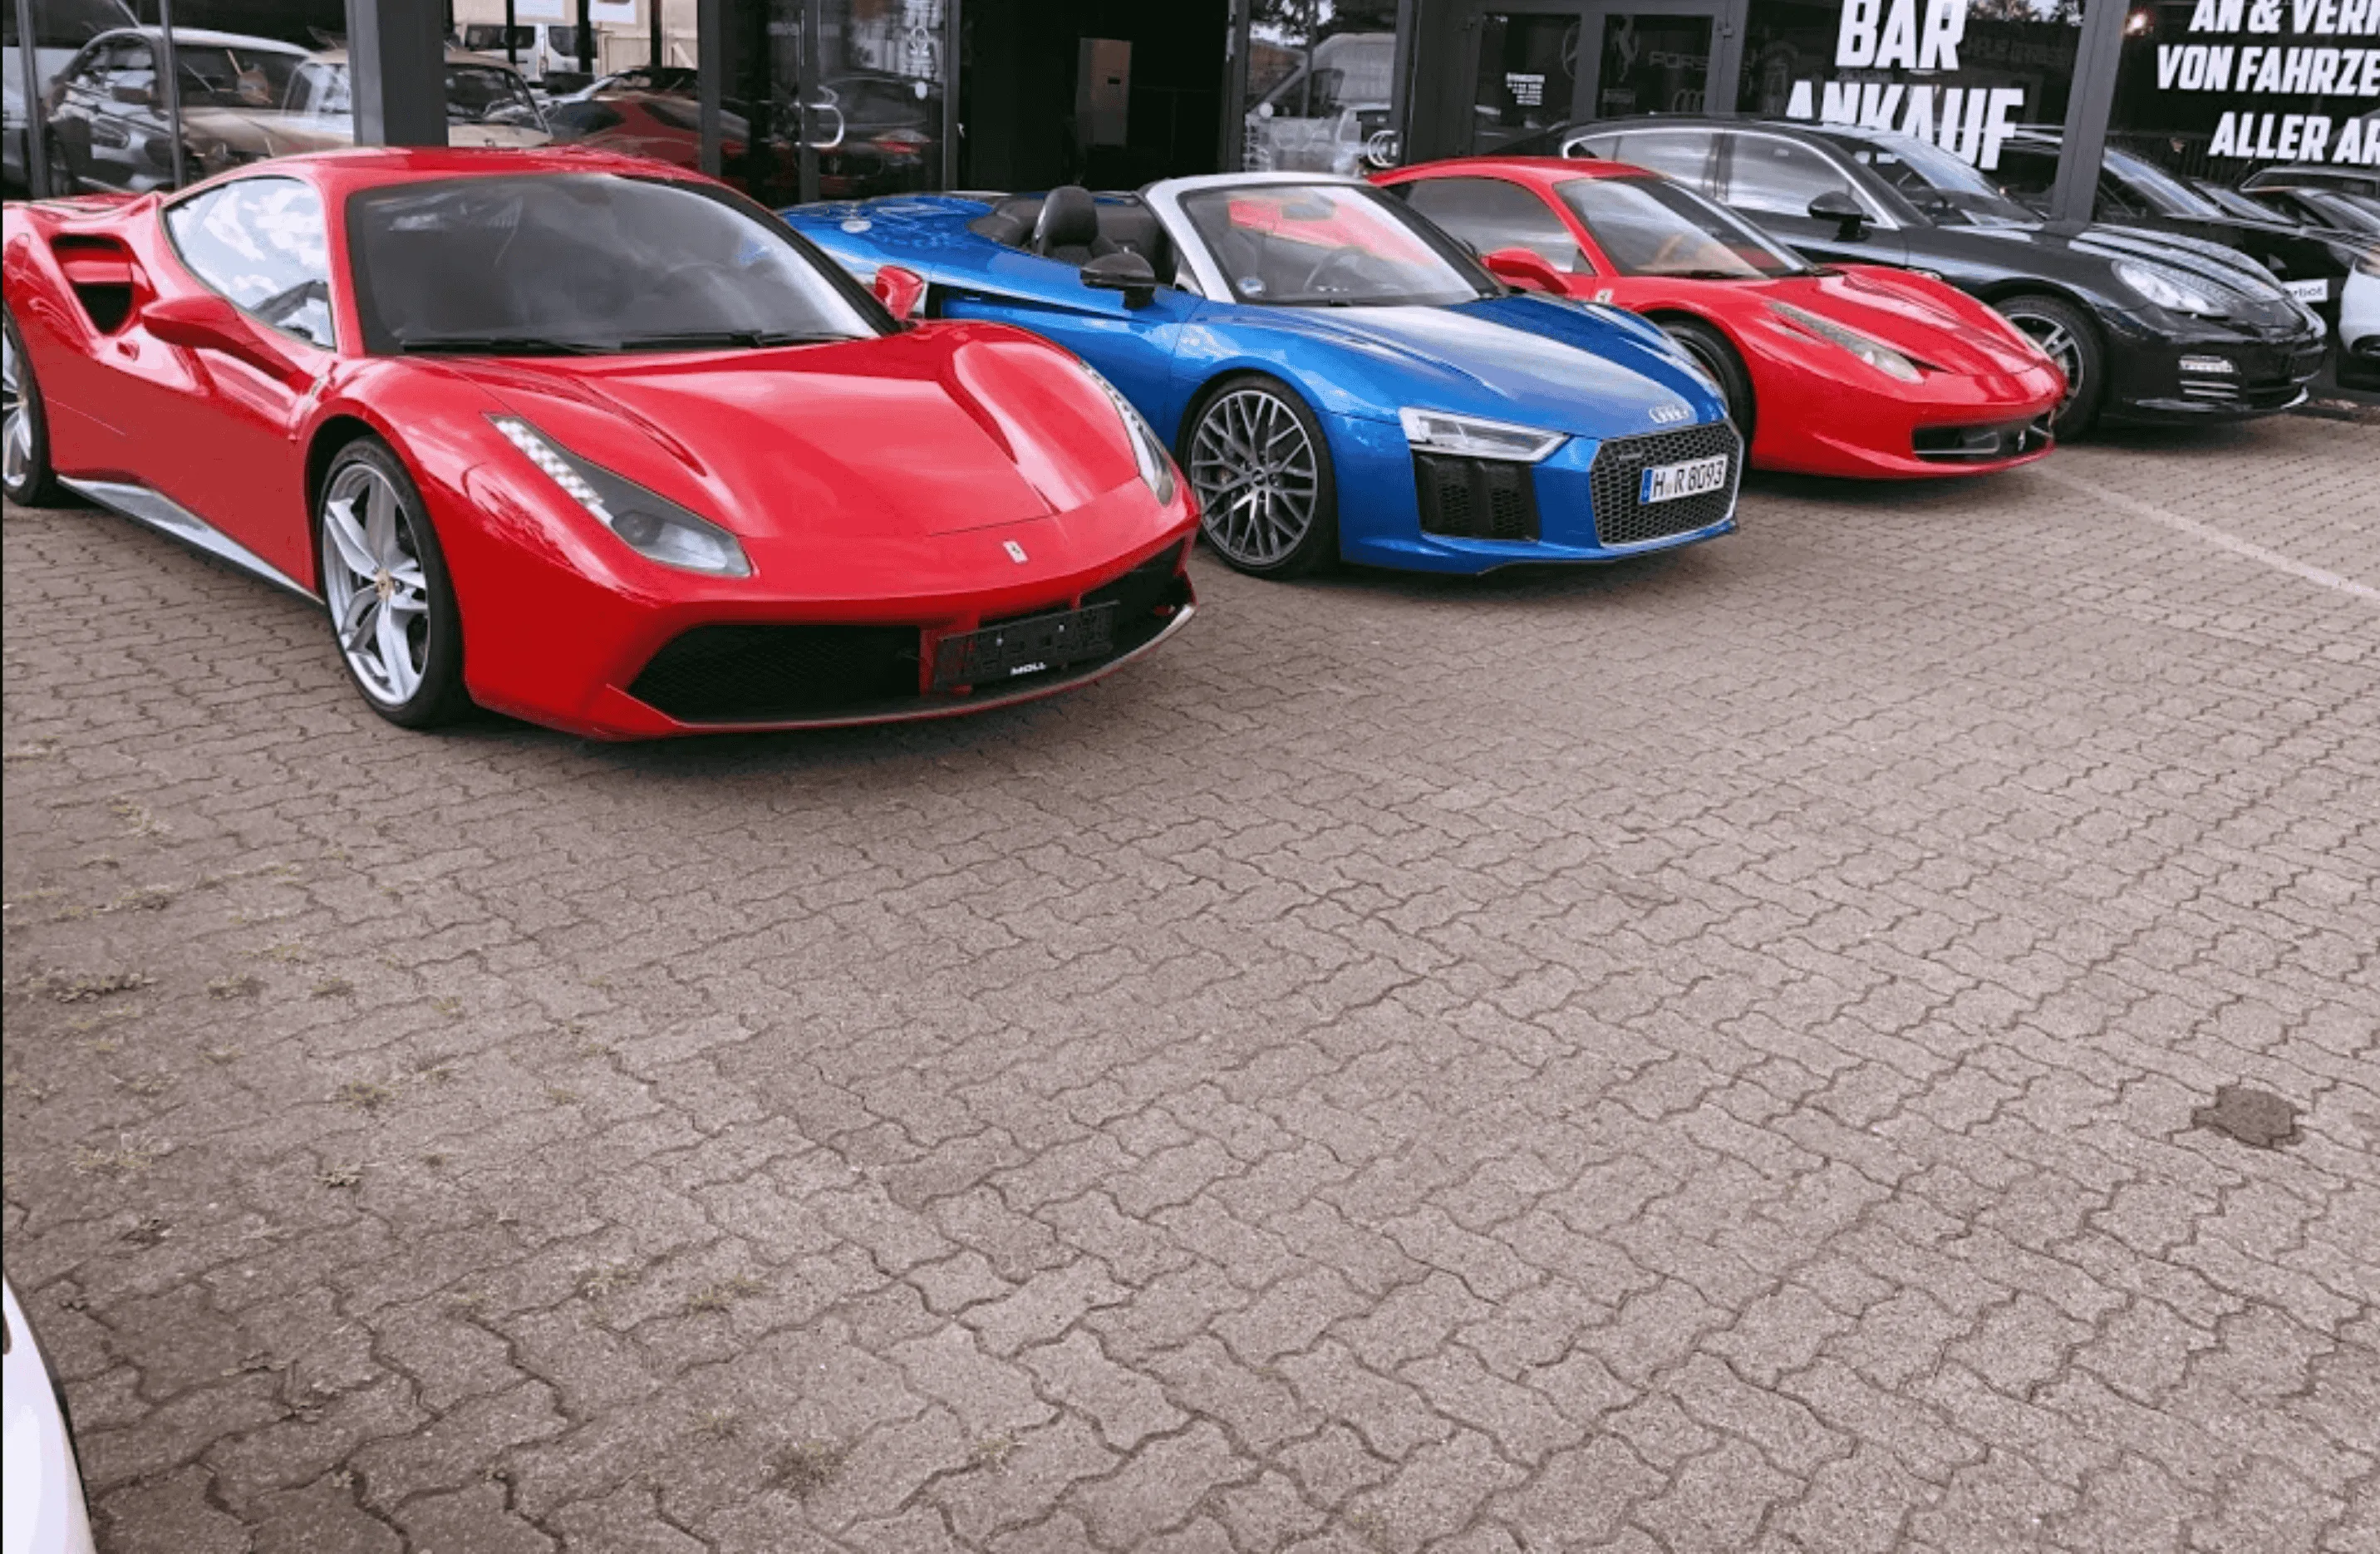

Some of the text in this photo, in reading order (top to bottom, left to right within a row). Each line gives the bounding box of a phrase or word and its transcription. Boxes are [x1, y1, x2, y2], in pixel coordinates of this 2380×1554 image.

[1835, 0, 1967, 70] BAR
[2188, 0, 2244, 32] AN
[2248, 0, 2284, 33] &
[2157, 45, 2380, 96] VON FAHRZE
[2207, 111, 2332, 161] ALLER
